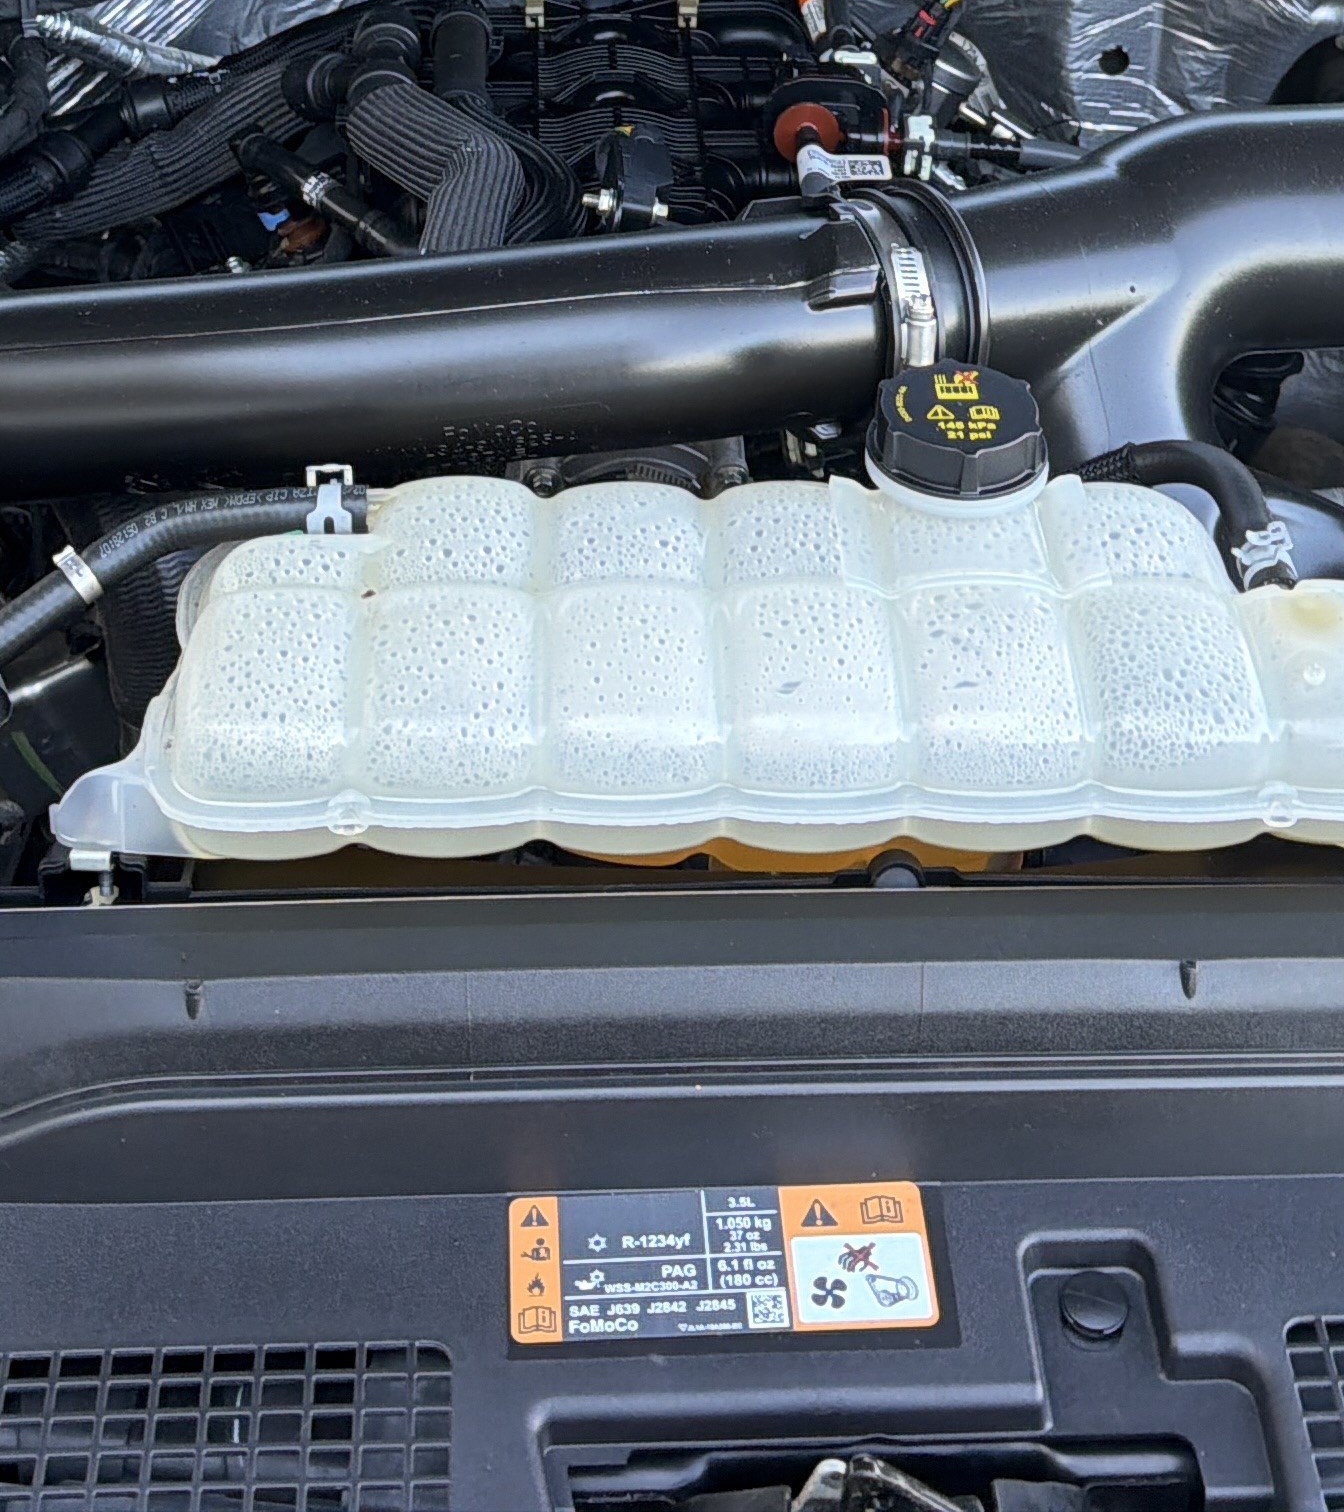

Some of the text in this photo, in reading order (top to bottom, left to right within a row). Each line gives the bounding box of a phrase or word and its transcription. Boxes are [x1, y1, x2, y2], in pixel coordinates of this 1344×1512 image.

[968, 420, 997, 431] kPa
[946, 430, 992, 441] 21 psi
[727, 1196, 755, 1208] 3.5L
[716, 1215, 772, 1232] 1.050 kg
[621, 1233, 691, 1249] R-1234yf
[729, 1230, 760, 1241] 37 oz
[723, 1241, 768, 1253] 2.31 lbs
[660, 1263, 697, 1278] PAG
[717, 1258, 776, 1272] 6.1 fl oz
[720, 1273, 778, 1289] (180 cc)
[568, 1298, 736, 1317] SAE J639 J2842 J2845
[568, 1317, 639, 1334] FoMoCo
